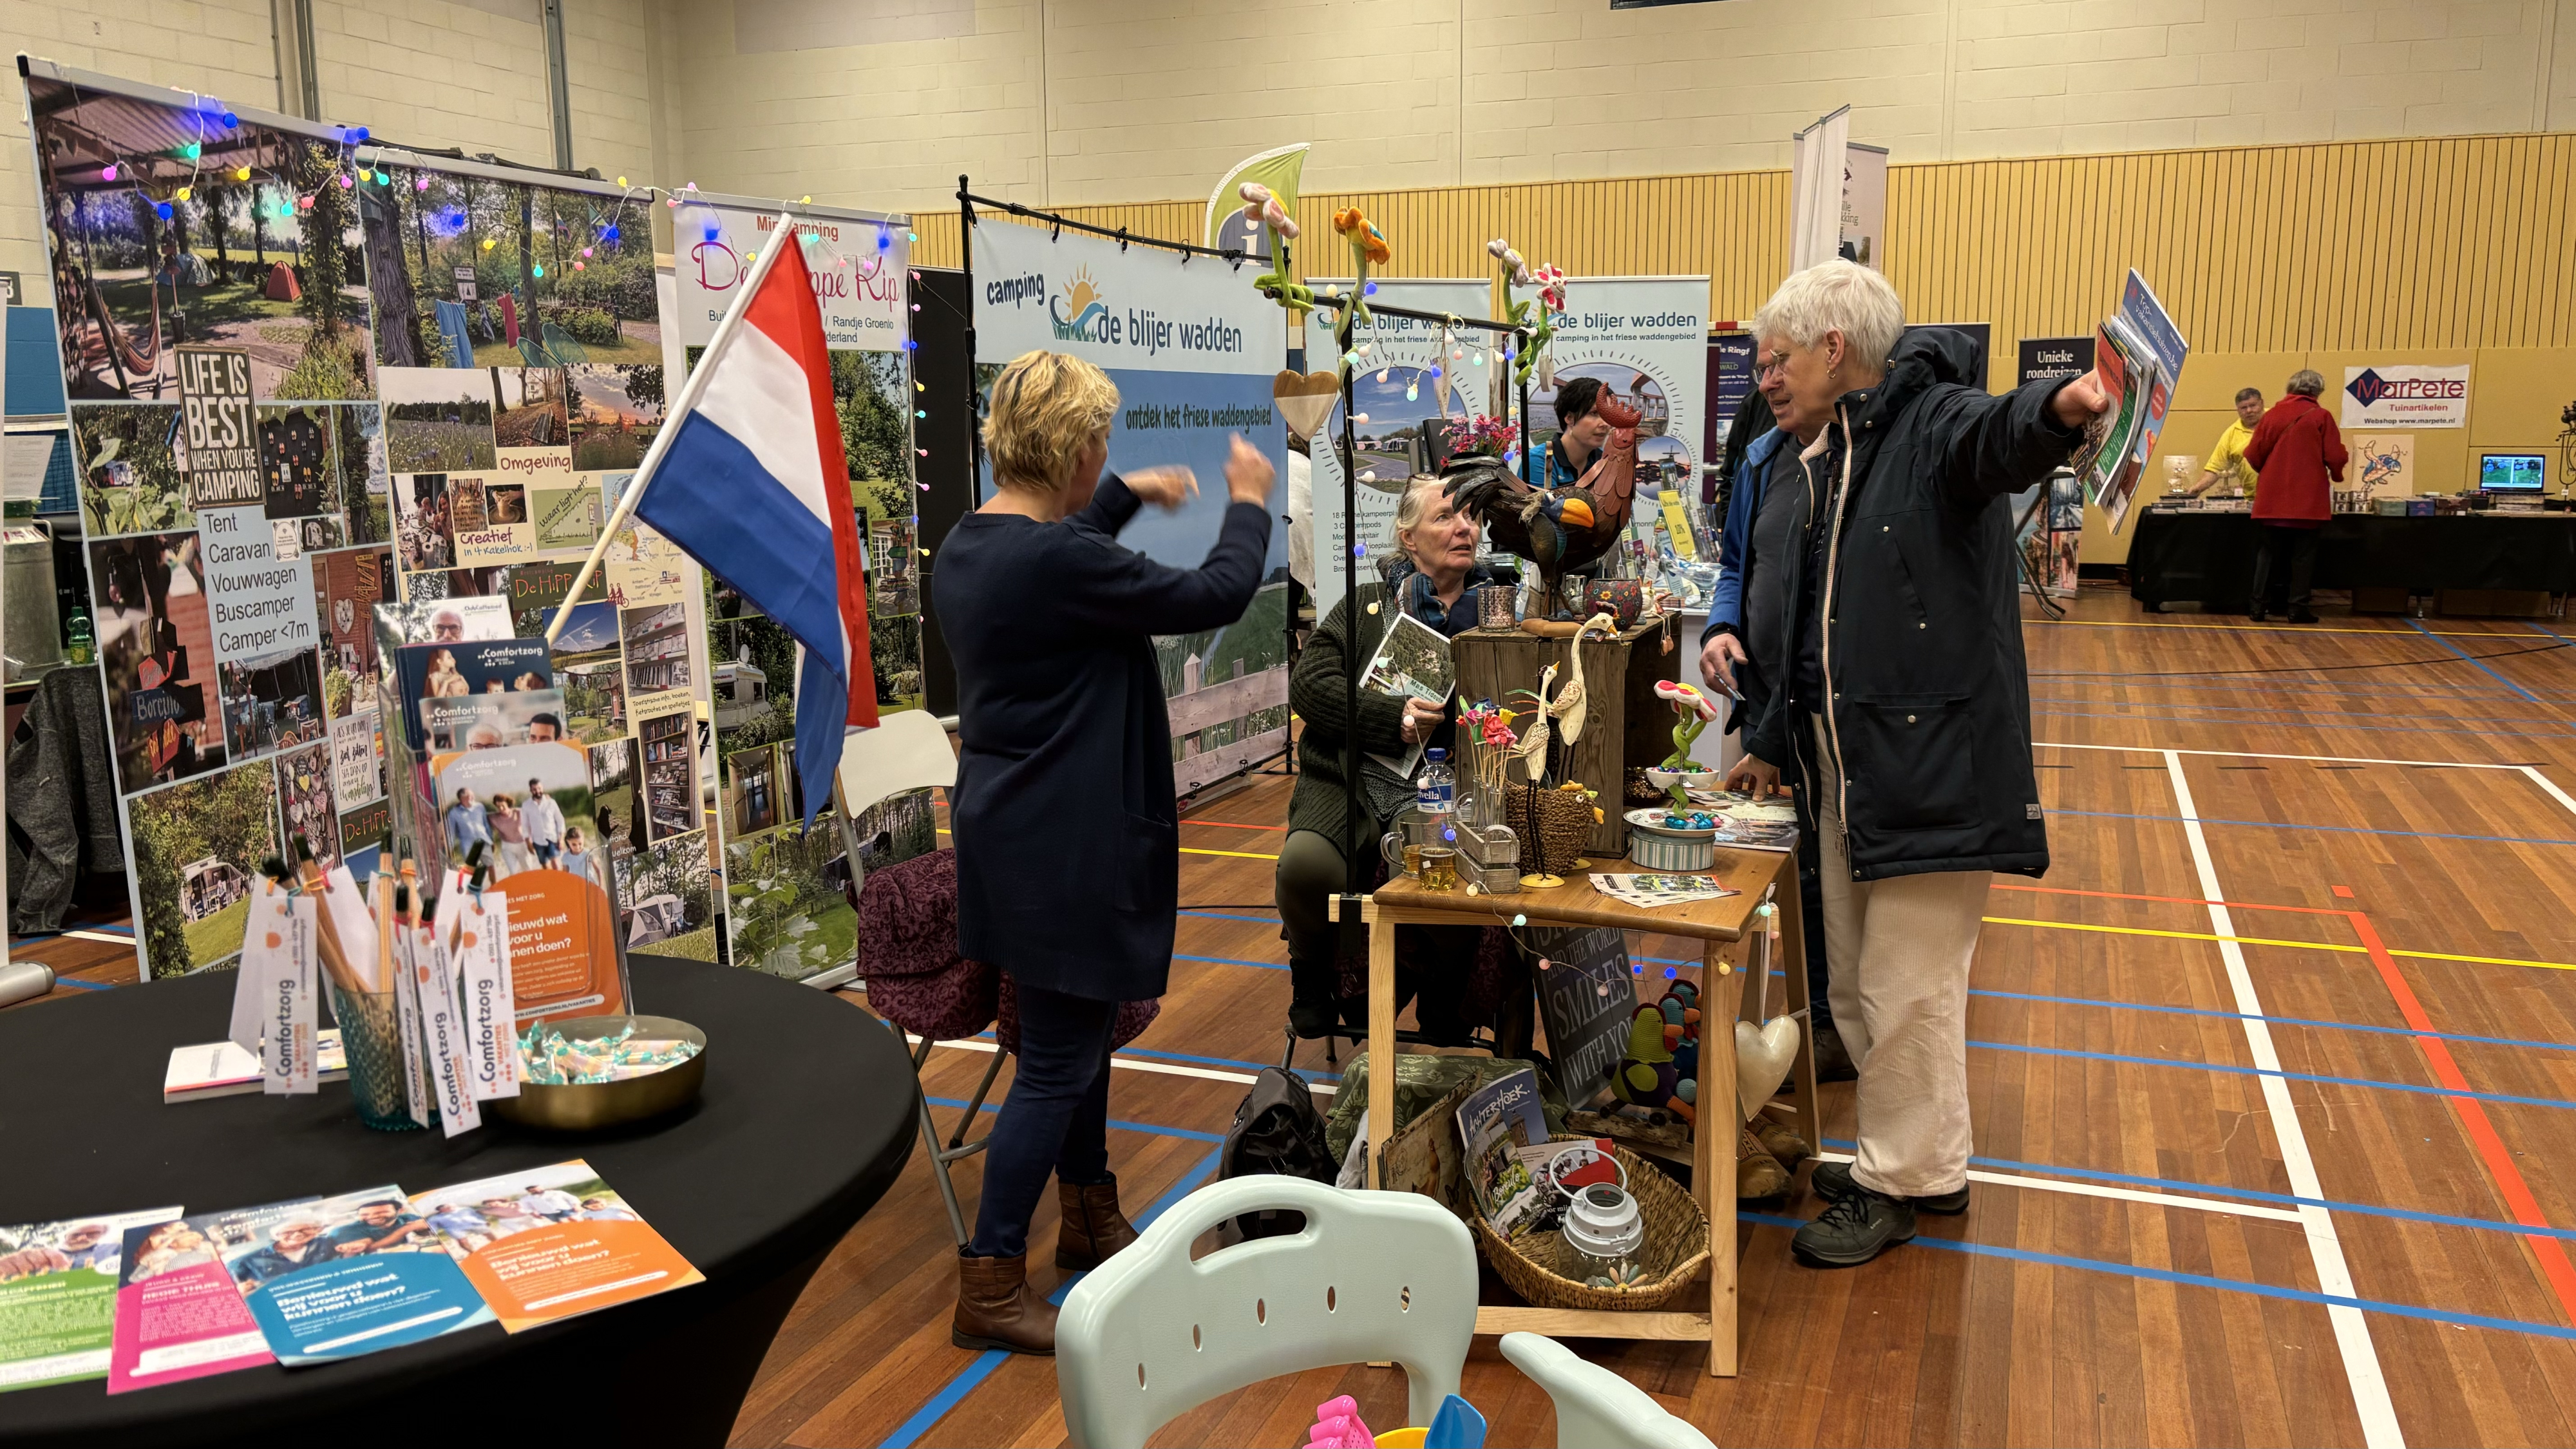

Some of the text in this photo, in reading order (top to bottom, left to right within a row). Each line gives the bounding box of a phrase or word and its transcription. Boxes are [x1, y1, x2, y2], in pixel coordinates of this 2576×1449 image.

[757, 216, 838, 242] Miamping
[855, 254, 900, 313] Kip
[833, 316, 863, 330] Randje
[865, 317, 895, 330] Groenlo
[987, 270, 1242, 357] camping de blijer wadden
[1378, 314, 1414, 334] blijer
[1558, 312, 1697, 332] de blijer wadden
[824, 331, 858, 343] lderland
[1352, 336, 1383, 345] campng
[1555, 334, 1589, 343] camping
[1615, 333, 1638, 341] friese
[1639, 332, 1696, 343] waddengebied
[2037, 349, 2074, 364] Unieke
[179, 353, 248, 395] LIFE IS
[2356, 377, 2465, 399] MarPete
[185, 397, 251, 449] BEST
[1126, 402, 1272, 435] ontdek het friese waddengebied
[191, 448, 257, 470] WHEN YOU'RE
[500, 452, 571, 475] Omgeving
[194, 469, 260, 502] CAMPING
[204, 512, 238, 534] Tent
[460, 526, 513, 545] Creatief
[209, 542, 271, 564] Caravan
[212, 567, 297, 594] Vouwwagen
[515, 579, 536, 598] De
[538, 573, 573, 595] HiPP
[216, 596, 295, 623] Buscamper
[220, 621, 309, 652] Camper <7m
[484, 647, 543, 658] Comfortzorg
[434, 705, 498, 717] Comfortzorg
[509, 913, 569, 933] ieuwd wat
[511, 937, 571, 958] nen doen?
[535, 931, 543, 941] u
[1547, 952, 1567, 981] AND
[1566, 937, 1587, 967] THE
[1584, 926, 1621, 956] WORLD
[515, 998, 596, 1018] WW.COMFORTZORG.NL/VAKANTIES
[1553, 953, 1631, 1041] SMILES
[275, 979, 295, 1077] Comfortzorg
[477, 978, 495, 1083] Comfortzorg
[435, 1012, 459, 1116] Comfortzorg
[1565, 1041, 1610, 1090] WITH
[491, 1238, 602, 1269] Benieuwd wat
[562, 1249, 611, 1265] doen?
[276, 1273, 400, 1307] Benieuwd wat
[308, 1293, 348, 1307] voor
[284, 1285, 406, 1322] kunnen doen?
